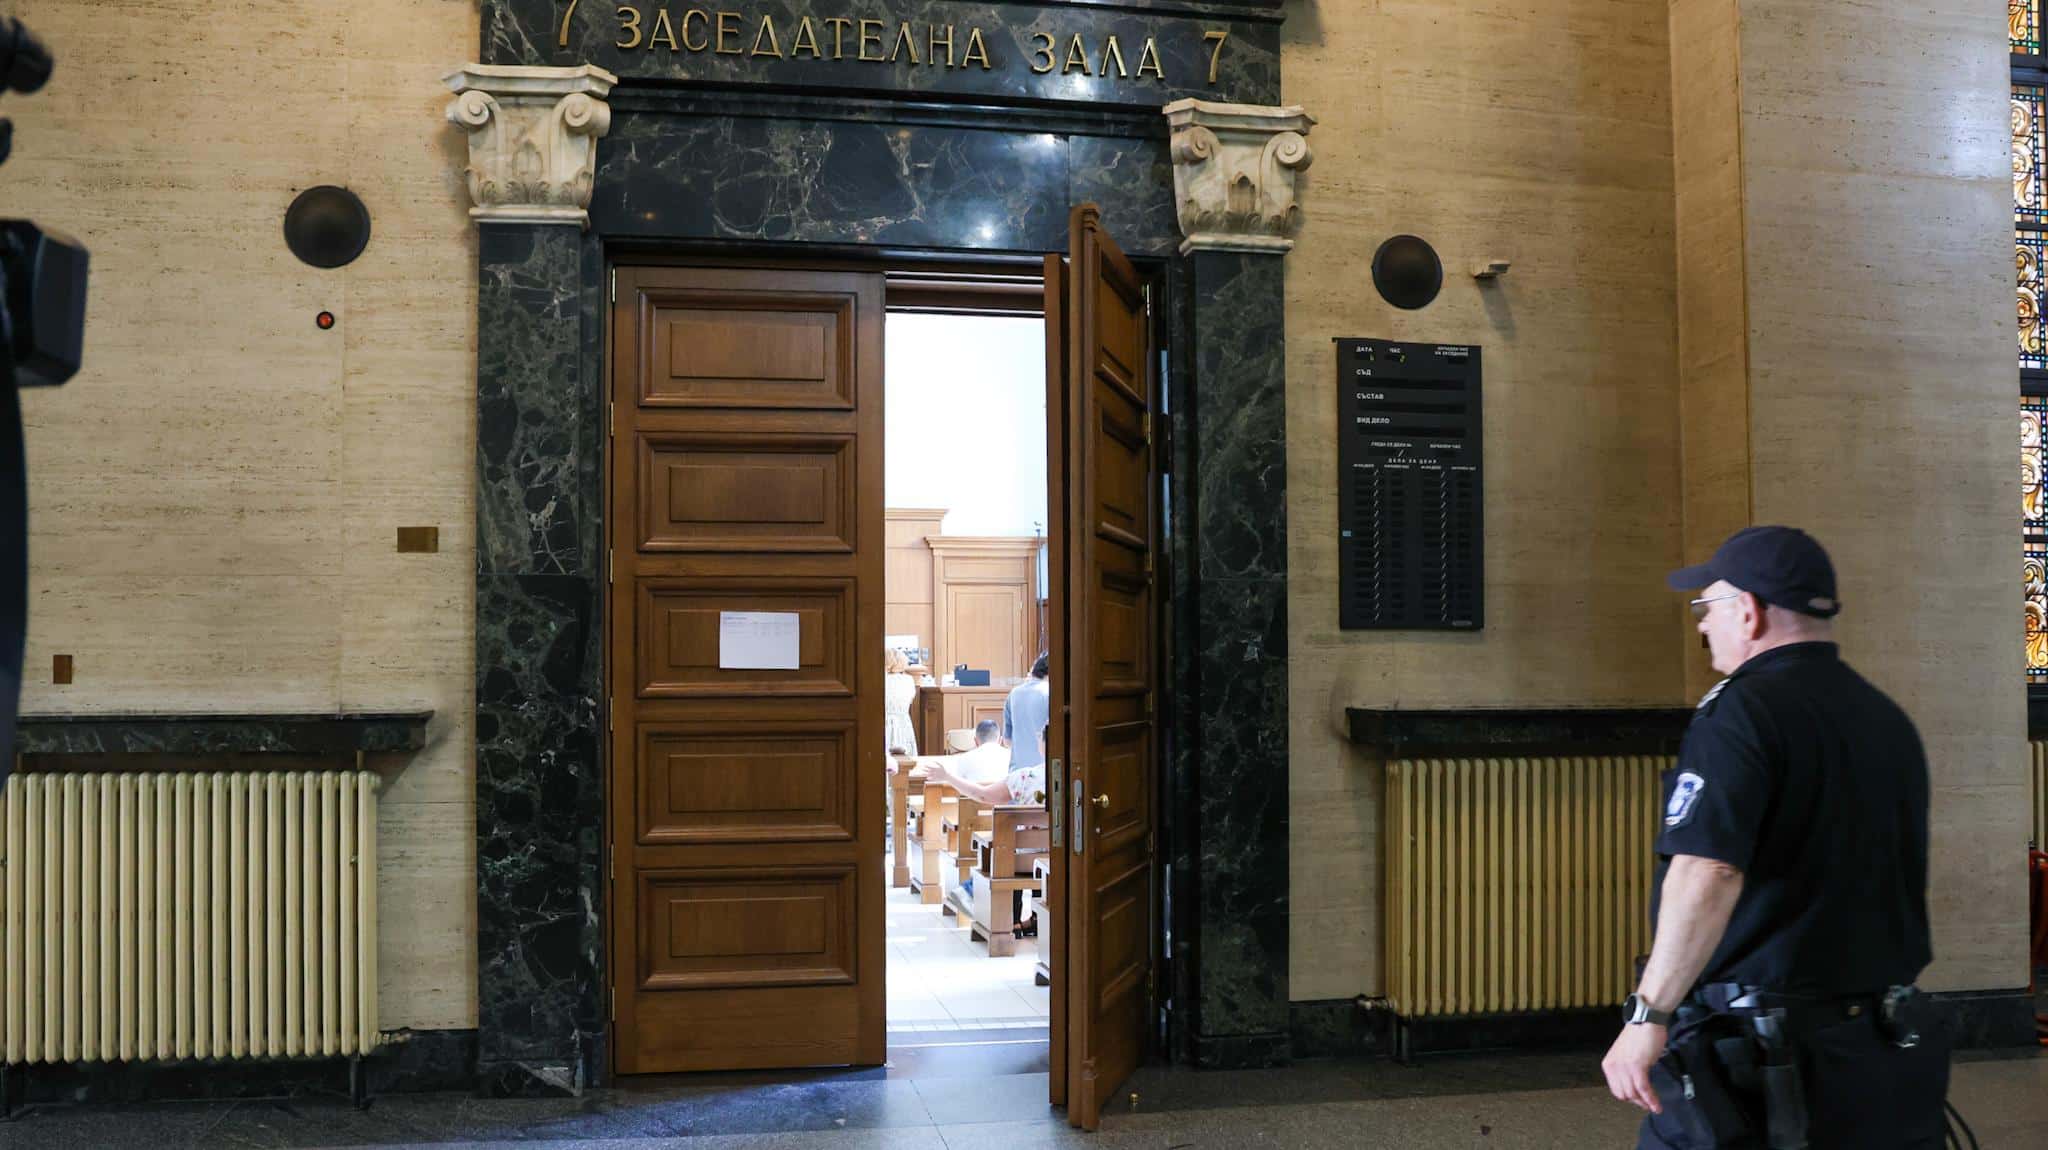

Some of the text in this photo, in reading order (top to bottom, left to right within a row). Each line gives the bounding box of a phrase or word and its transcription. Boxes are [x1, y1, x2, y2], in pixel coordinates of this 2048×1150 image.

[559, 0, 1228, 83] 7 ЗАСЕДАТЕЛНА ЗАЛА 7
